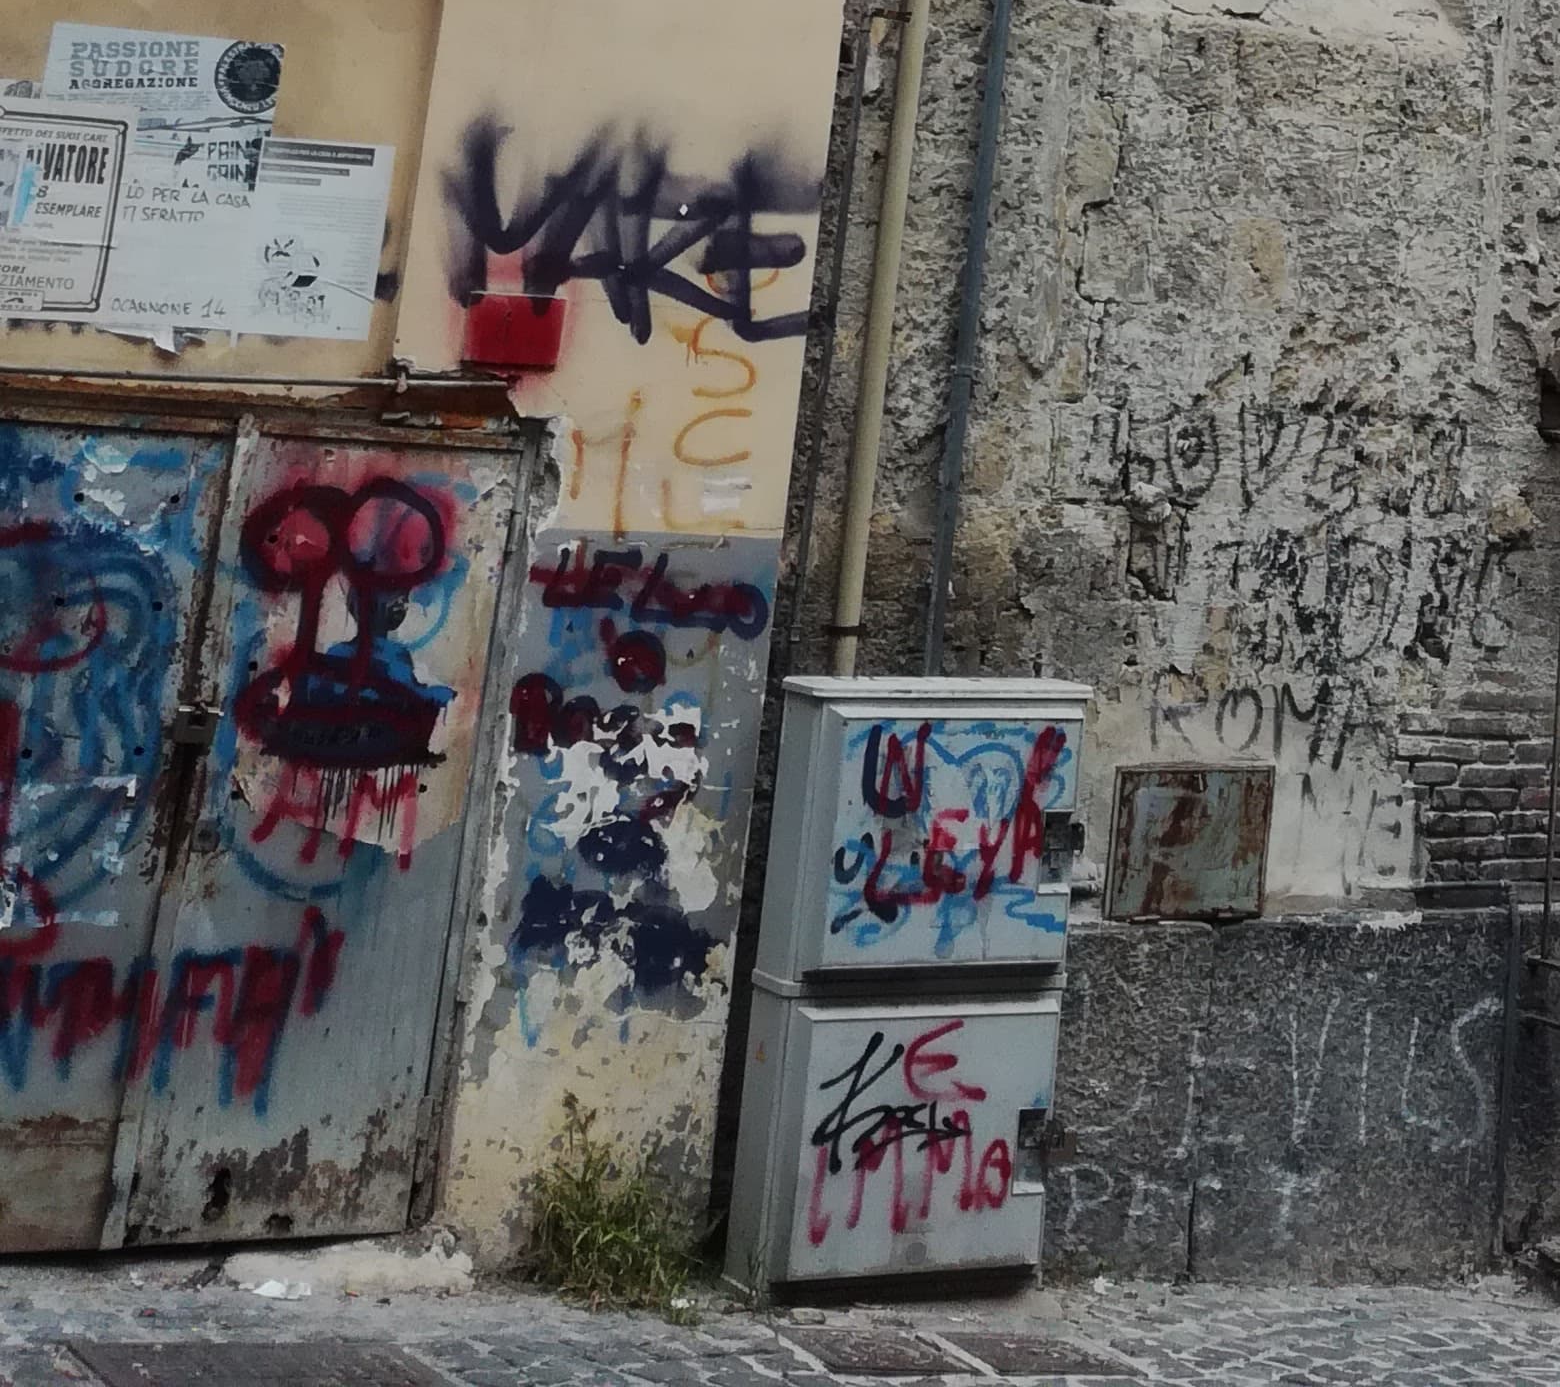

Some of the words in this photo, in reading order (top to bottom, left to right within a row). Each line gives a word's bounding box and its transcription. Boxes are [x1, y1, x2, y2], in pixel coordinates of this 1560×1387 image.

[71, 40, 200, 60] PASSIONE
[68, 58, 199, 77] SUDORE
[68, 76, 199, 91] AGGREGAZIONE
[152, 187, 180, 202] PER
[216, 193, 251, 208] CASA
[35, 203, 103, 218] ESEMPLARE
[142, 206, 204, 223] SFRATTO
